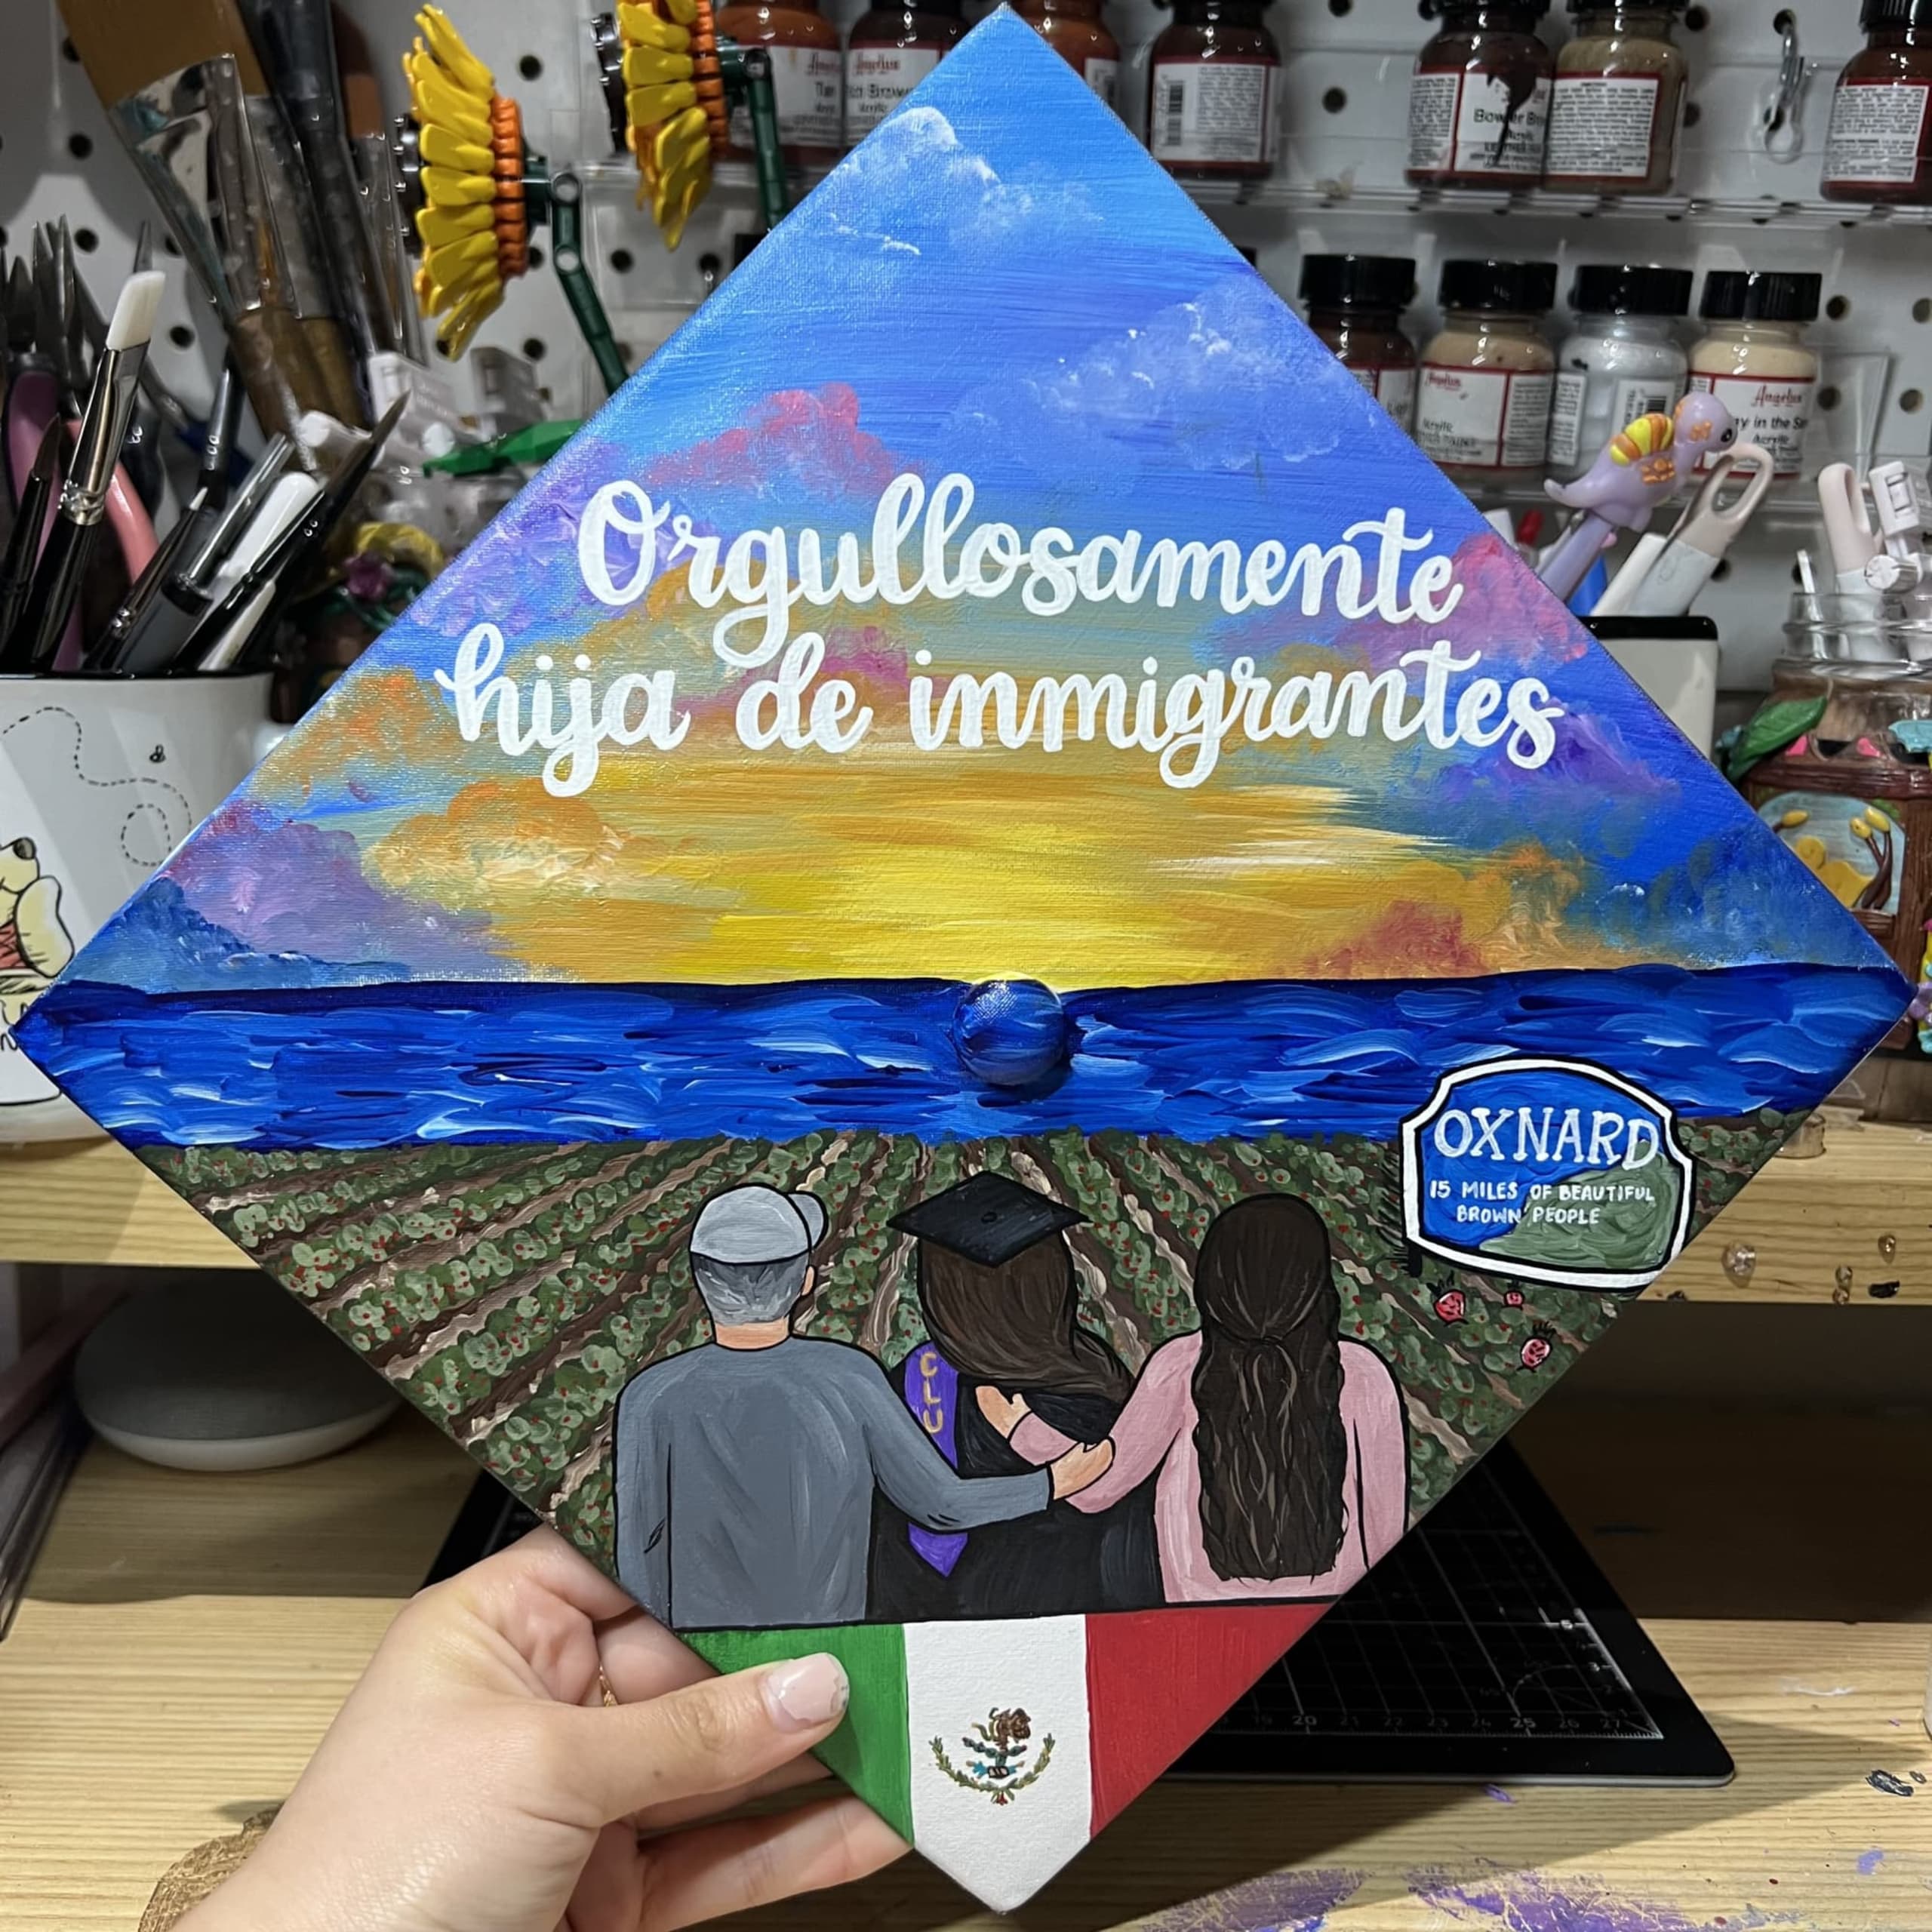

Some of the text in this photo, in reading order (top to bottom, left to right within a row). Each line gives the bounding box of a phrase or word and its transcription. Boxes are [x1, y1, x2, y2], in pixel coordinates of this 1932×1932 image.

[1770, 415, 1791, 429] the
[578, 473, 1463, 668] Orgullosamente
[433, 623, 1565, 798] hija de inmigrantes
[1433, 1107, 1660, 1171] OXNARD
[1429, 1180, 1655, 1201] 15 MILES OF BEAUTIFUL
[1457, 1204, 1600, 1225] BROWN PEOPLE
[921, 1351, 943, 1433] CLU
[1292, 1715, 1318, 1725] 20
[1510, 1717, 1537, 1729] 25
